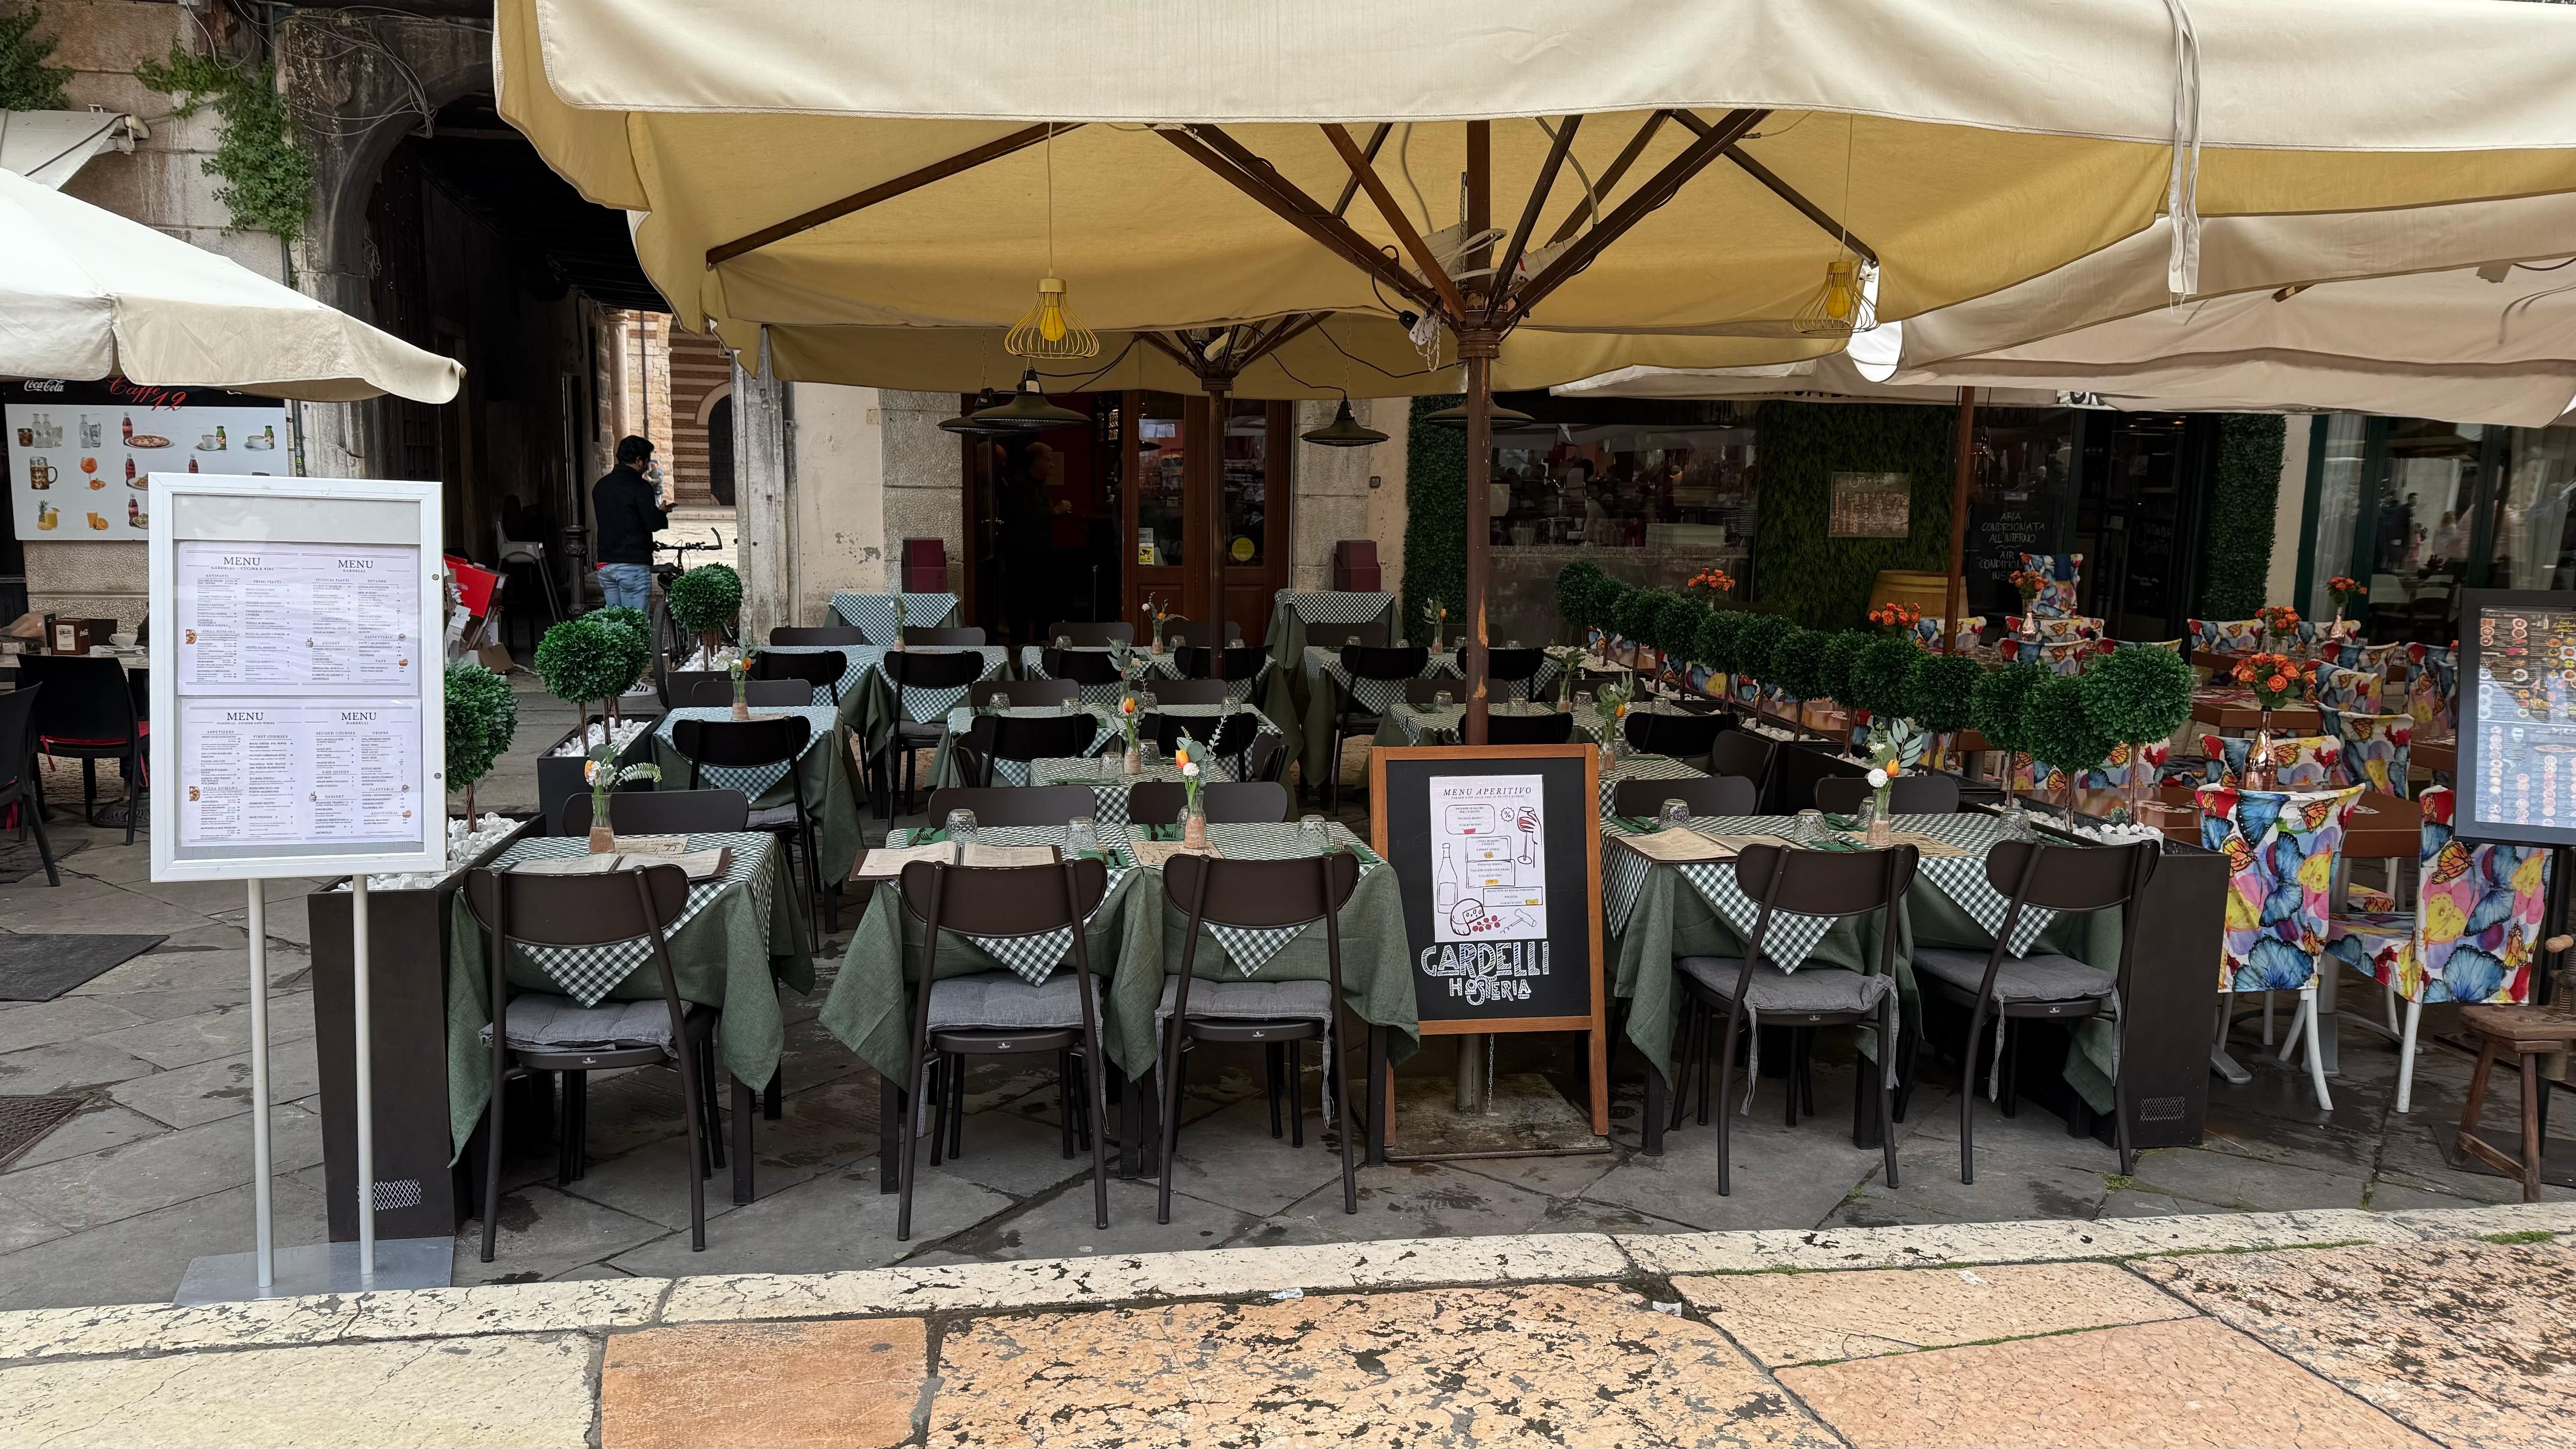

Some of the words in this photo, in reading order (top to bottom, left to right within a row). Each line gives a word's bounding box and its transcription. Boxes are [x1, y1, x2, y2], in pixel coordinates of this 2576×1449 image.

[2000, 512, 2021, 522] ARIA
[1981, 522, 2045, 532] CONDIZIONATA
[1989, 532, 2036, 543] ALL'INTERNO
[1999, 551, 2015, 559] AIR
[224, 556, 260, 566] MENU
[338, 559, 373, 569] MENU
[1979, 557, 2021, 569] CONDITION
[227, 712, 264, 720] MENU
[341, 712, 377, 720] MENU
[1476, 787, 1532, 795] APERITIVO
[1421, 941, 1549, 978] GARDELLI
[1449, 975, 1532, 1005] HOSTERIA
